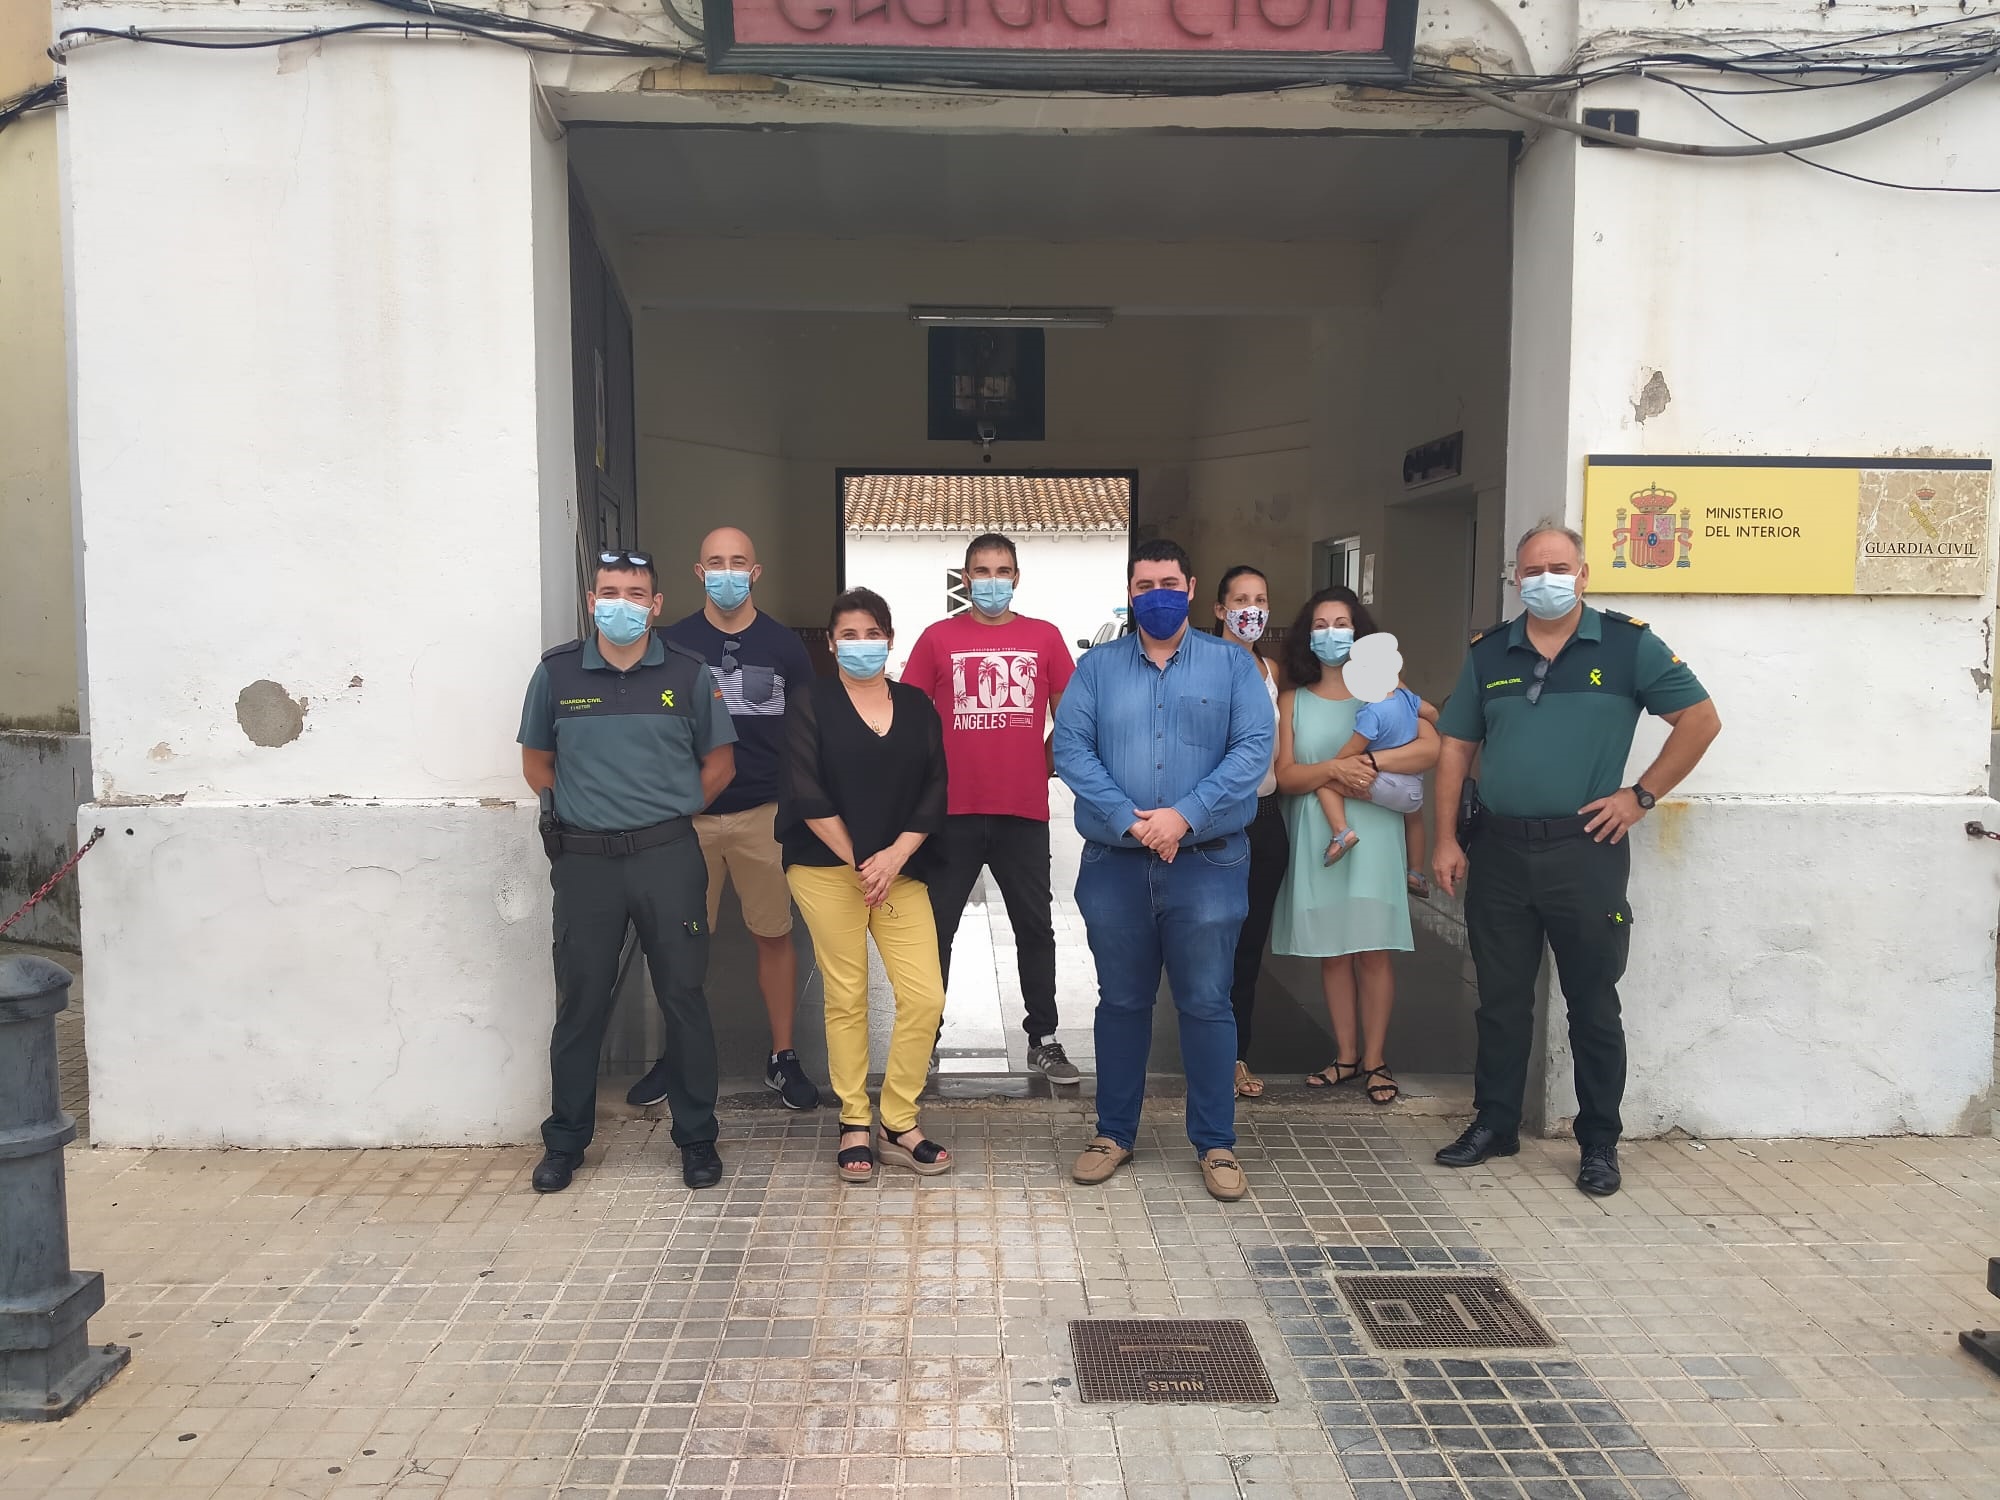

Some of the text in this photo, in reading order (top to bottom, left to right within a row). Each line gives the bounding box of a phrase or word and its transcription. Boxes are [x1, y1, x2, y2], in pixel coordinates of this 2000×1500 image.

[1705, 507, 1784, 520] MINISTERIO
[1705, 525, 1801, 539] DEL INTERIOR
[1865, 541, 1977, 556] GUARDIA CIVIL
[952, 652, 1038, 713] LOS
[953, 713, 1007, 730] ANGELES
[1147, 1380, 1205, 1392] NULES
